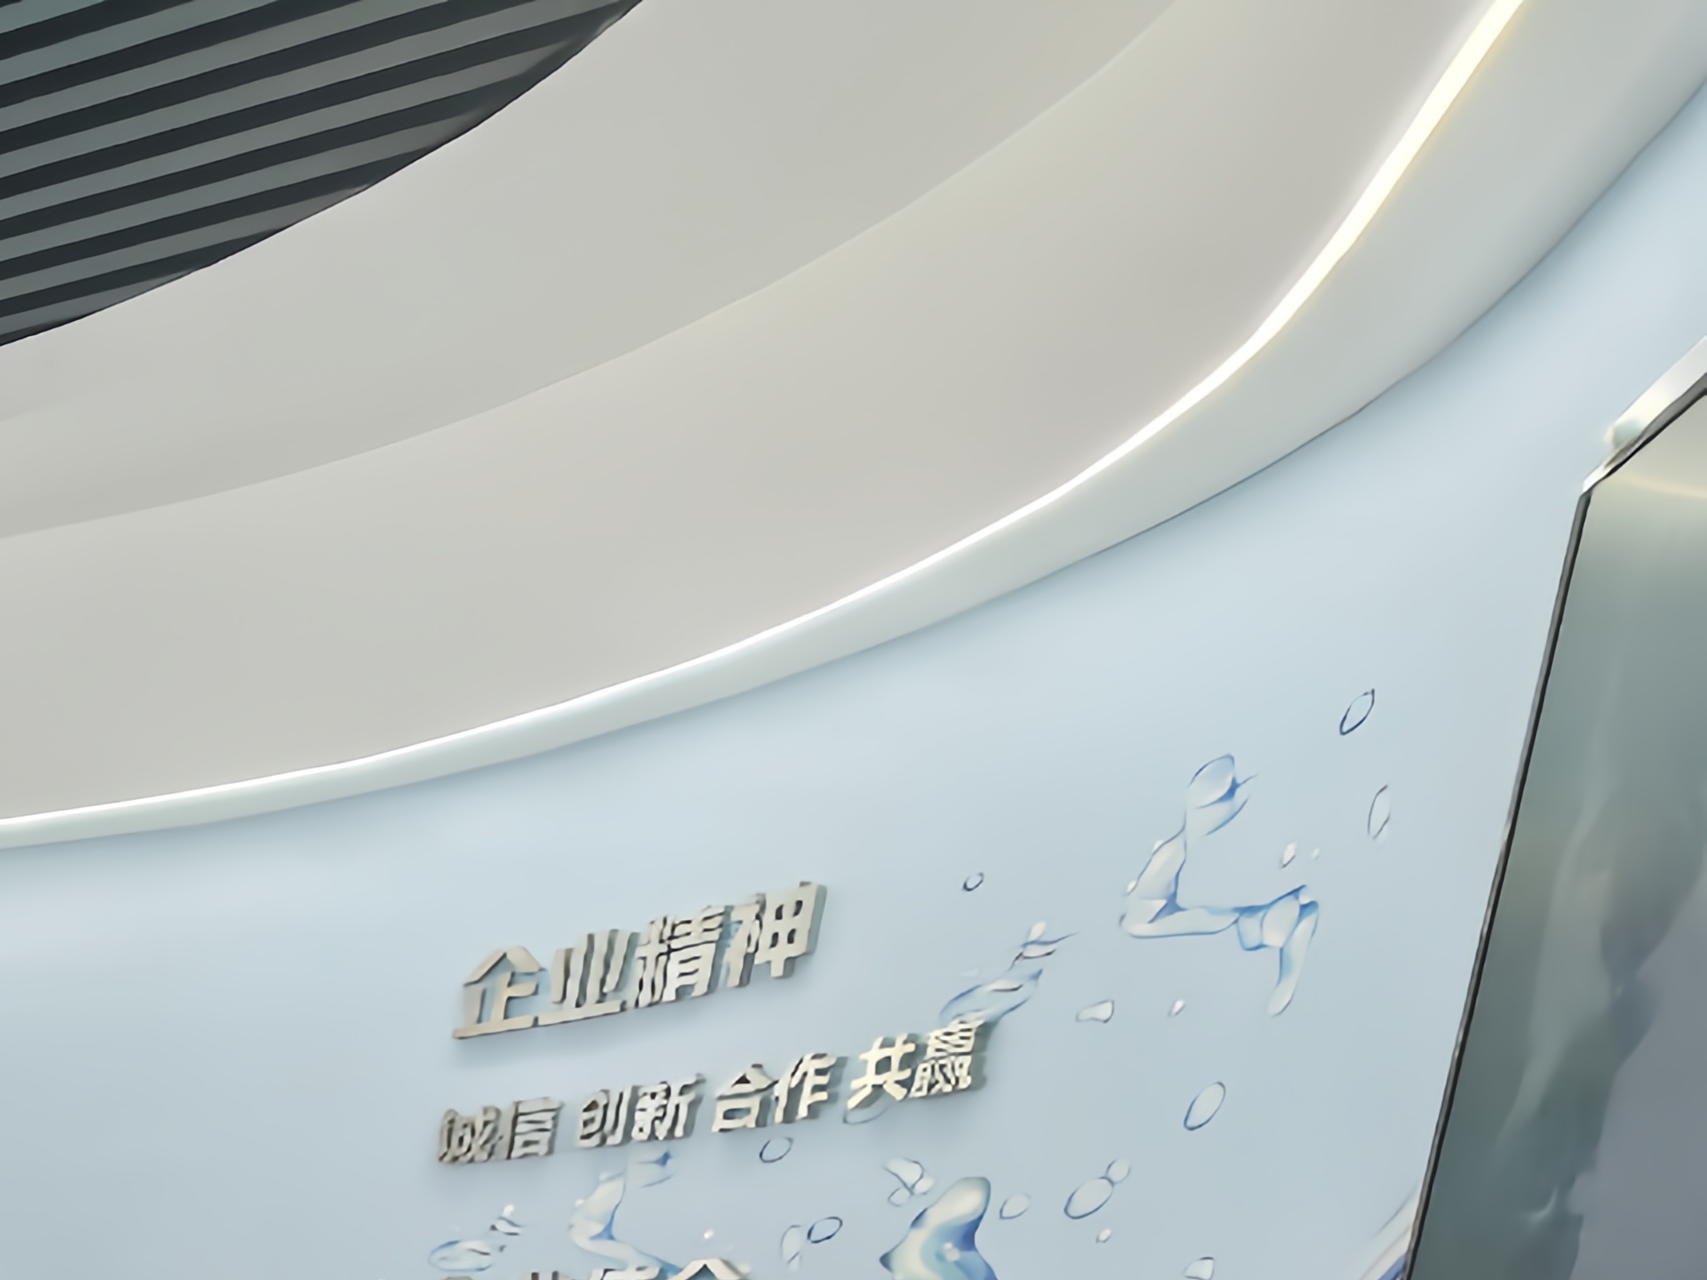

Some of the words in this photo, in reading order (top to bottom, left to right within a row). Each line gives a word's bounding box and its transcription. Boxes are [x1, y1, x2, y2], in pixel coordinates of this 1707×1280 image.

[452, 881, 827, 1039] 企业精神
[437, 1097, 563, 1164] 诚信
[577, 1074, 705, 1149] 创新
[711, 1052, 845, 1133] 合作
[847, 1018, 990, 1110] 共赢
